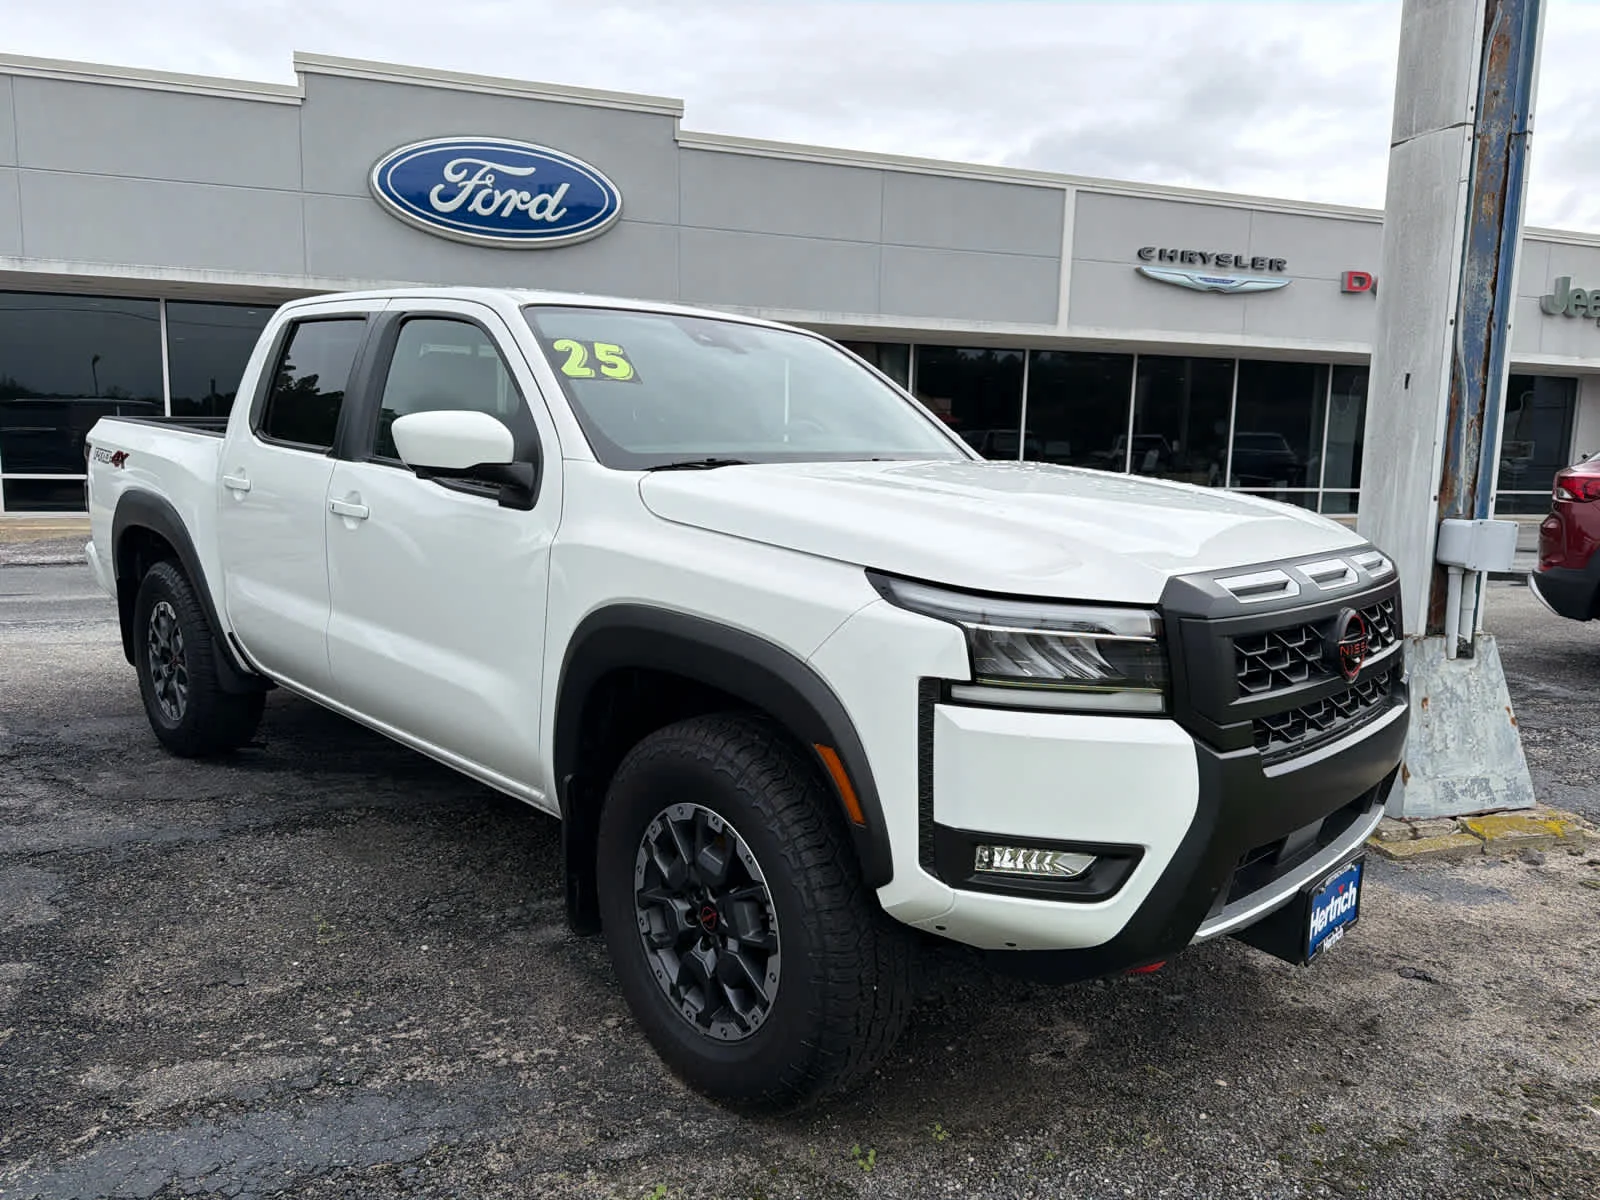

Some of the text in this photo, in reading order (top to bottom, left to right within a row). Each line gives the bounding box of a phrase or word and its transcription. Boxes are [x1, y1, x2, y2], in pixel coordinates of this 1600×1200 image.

[429, 158, 570, 222] Ford
[1137, 246, 1288, 272] CHRYSLER
[1539, 275, 1600, 328] Jee
[553, 339, 635, 381] 25
[1309, 880, 1357, 941] Hertrich
